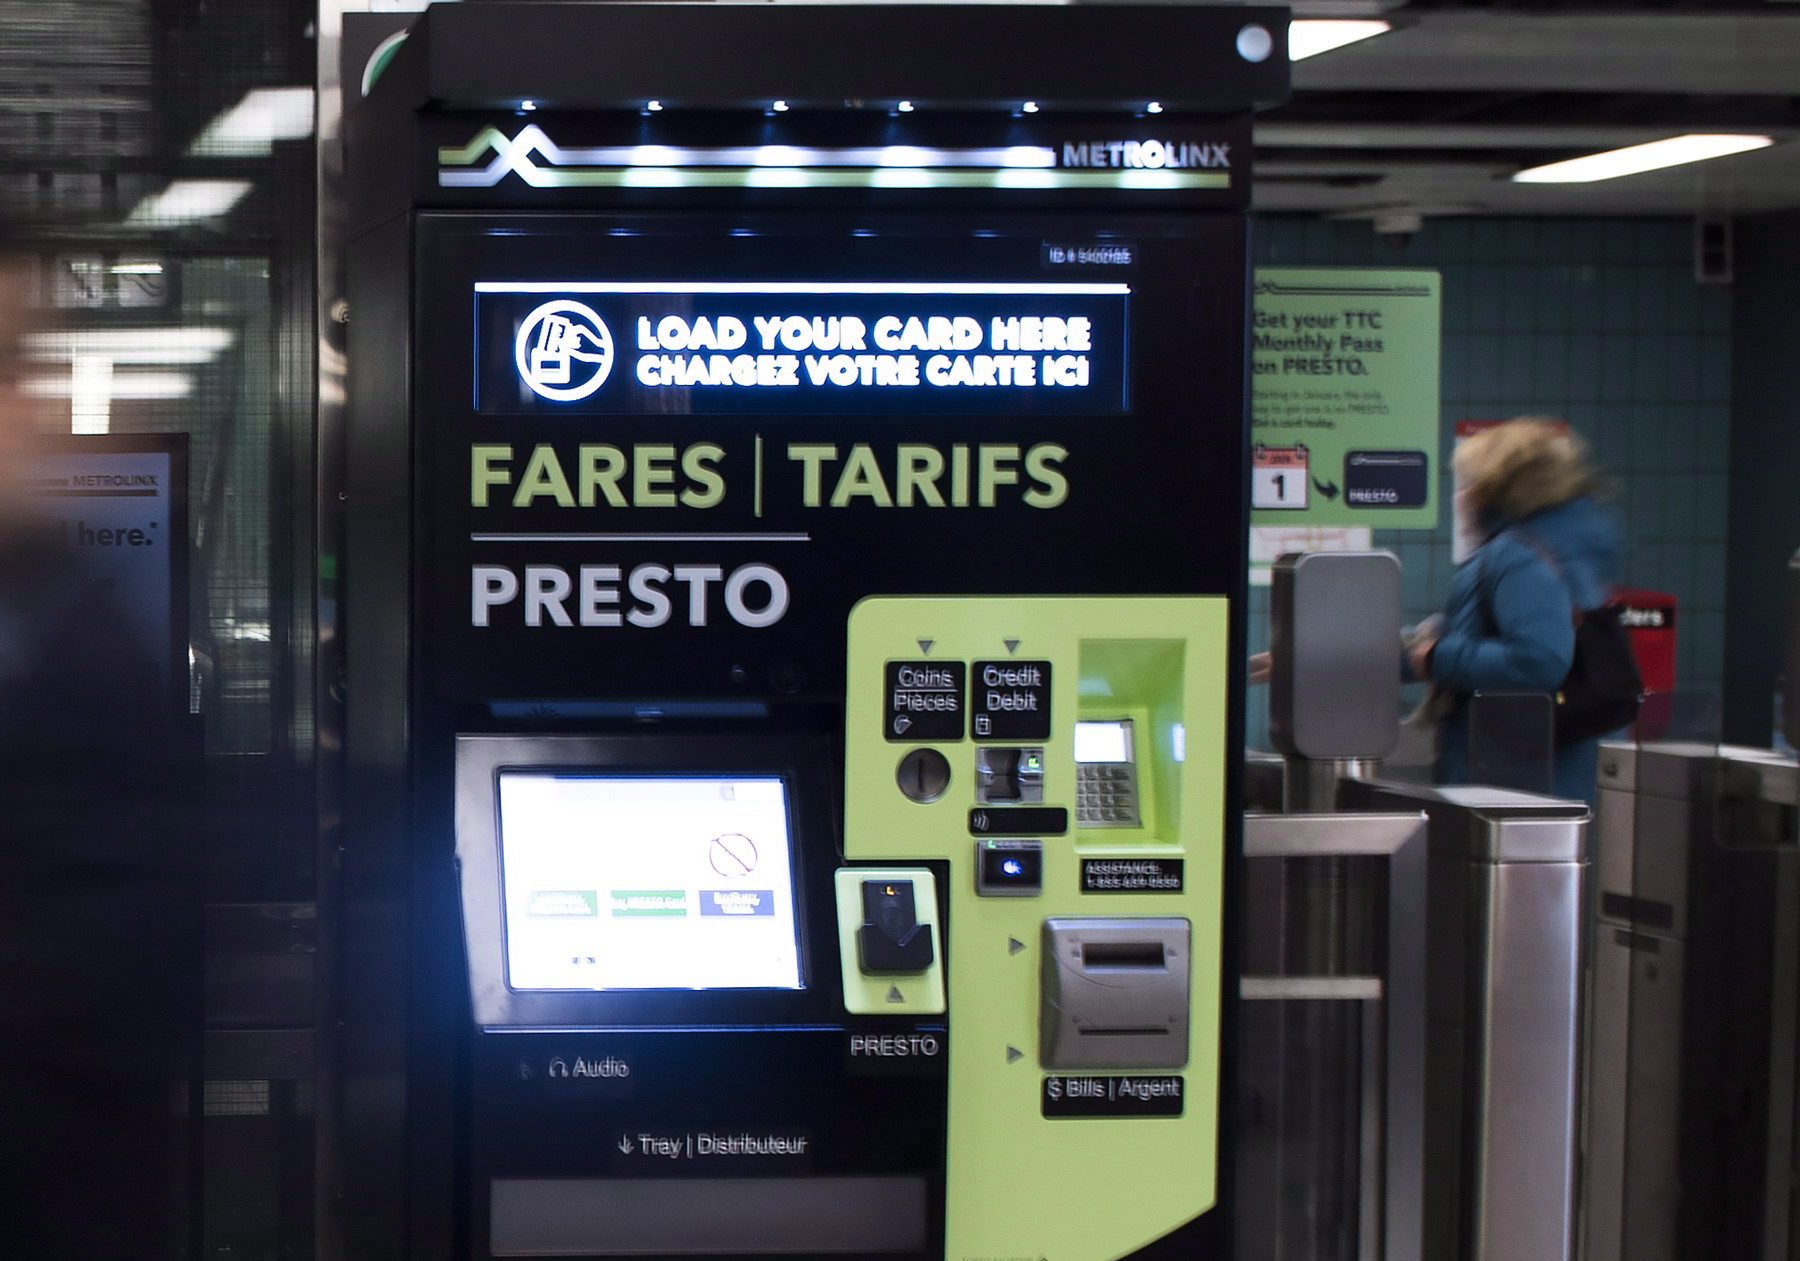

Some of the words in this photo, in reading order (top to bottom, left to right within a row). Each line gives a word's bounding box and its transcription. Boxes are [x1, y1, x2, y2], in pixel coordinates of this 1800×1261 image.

[1063, 139, 1232, 168] METROLINX
[1253, 311, 1288, 329] Get
[1292, 313, 1337, 333] your
[1343, 311, 1383, 329] TTC
[636, 316, 748, 351] LOAD
[753, 316, 867, 351] YOUR
[873, 316, 983, 351] CARD
[991, 316, 1092, 351] HERE
[1252, 334, 1334, 356] Monthly
[1339, 335, 1385, 352] Pass
[635, 354, 800, 386] CHARGEZ
[804, 354, 921, 386] VOTRE
[925, 354, 1036, 386] CARTE
[1042, 354, 1089, 386] ICI
[1252, 360, 1278, 375] on
[1283, 357, 1369, 376] PRESTO.
[72, 474, 159, 488] METROLINX
[471, 441, 728, 509] FARES
[788, 441, 1071, 509] TARIFS
[1271, 474, 1285, 502] 1
[471, 563, 791, 628] PRESTO
[898, 665, 954, 687] Coins
[983, 665, 1042, 687] Credit
[987, 689, 1038, 711] Debit
[850, 1035, 939, 1057] PRESTO
[573, 1056, 629, 1078] Audio
[1066, 1077, 1106, 1098] Bills
[1119, 1077, 1181, 1101] Argent
[639, 1133, 683, 1159] Tray
[698, 1132, 807, 1156] Distributeur
